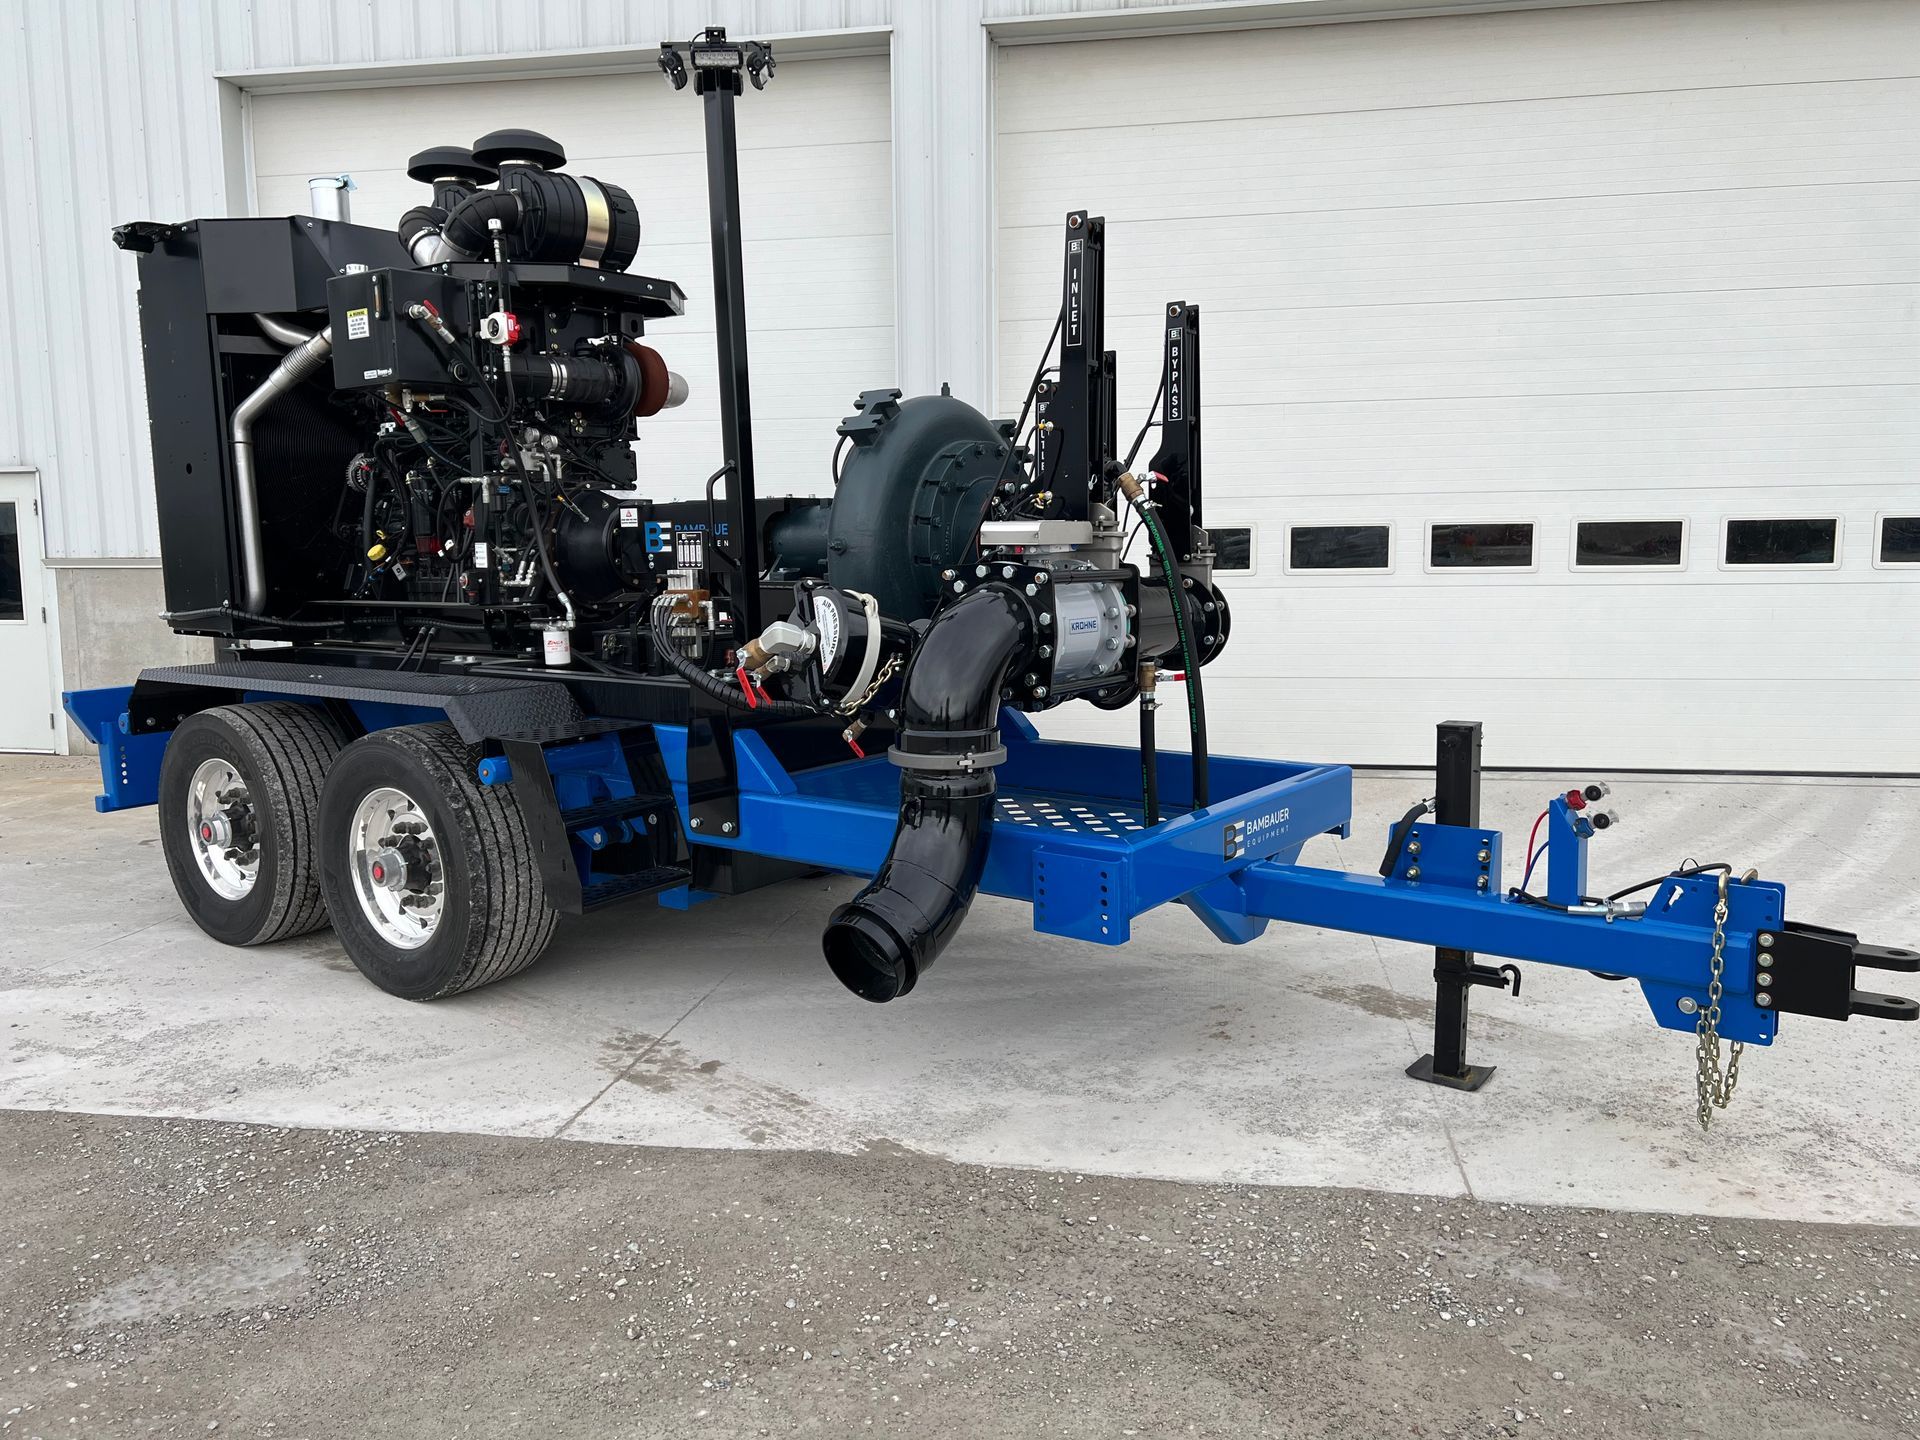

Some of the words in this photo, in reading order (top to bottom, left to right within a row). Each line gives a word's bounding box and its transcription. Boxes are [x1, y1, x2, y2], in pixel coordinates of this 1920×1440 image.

[1071, 267, 1079, 336] INLET
[1171, 346, 1179, 418] BYPASS
[822, 599, 833, 610] AIR
[828, 607, 839, 656] PRESSURE
[1071, 620, 1097, 631] KROHNE
[1246, 807, 1290, 836] BAMBAUER
[1246, 824, 1289, 848] EQUIPMENT
